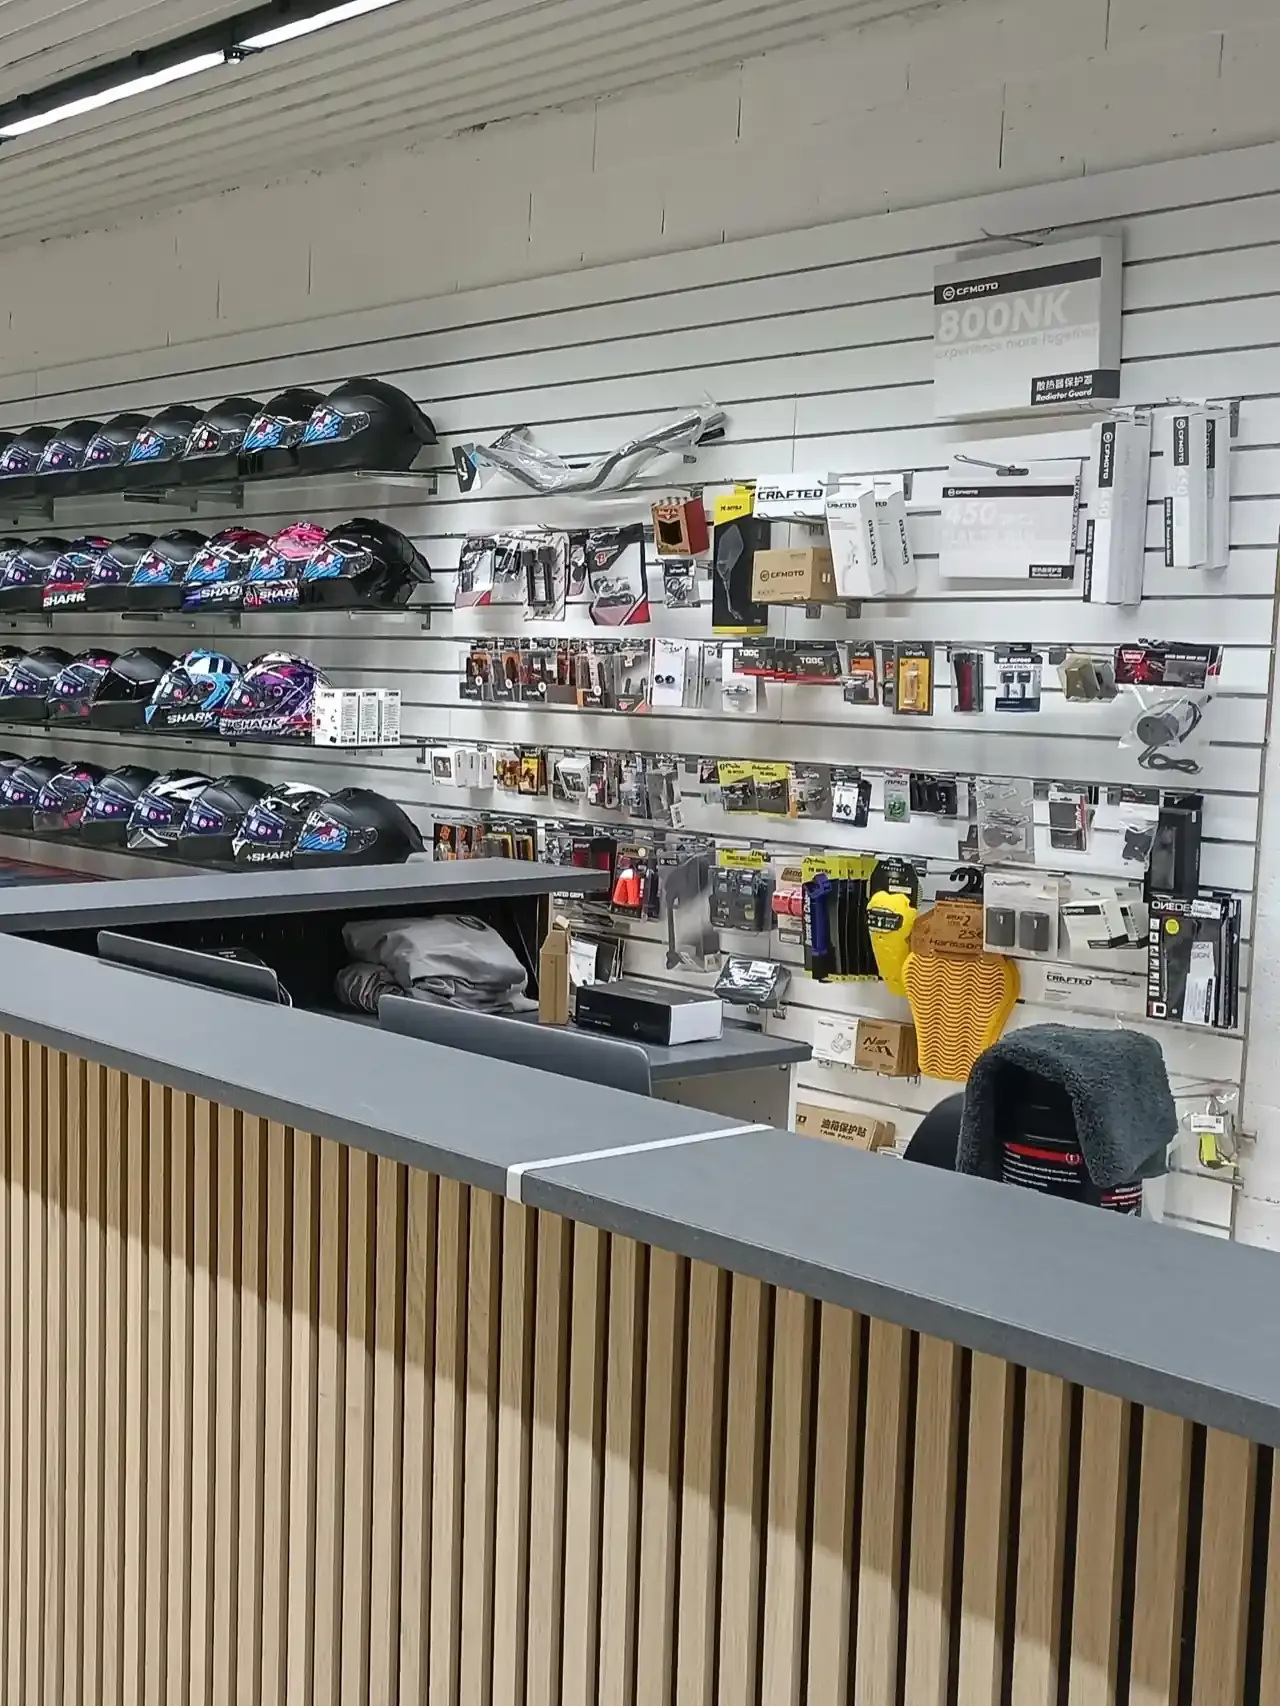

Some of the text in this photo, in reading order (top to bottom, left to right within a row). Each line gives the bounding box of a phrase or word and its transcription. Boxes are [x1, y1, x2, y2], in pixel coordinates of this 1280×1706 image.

[957, 282, 999, 296] CFMOTO
[938, 290, 1070, 343] 800NK
[1006, 335, 1040, 350] more
[1035, 388, 1093, 402] Radiator Guard
[757, 489, 823, 500] CRAFTED
[770, 570, 805, 578] CFMOTO
[43, 592, 86, 608] SHARK
[167, 712, 215, 723] SHARK
[1046, 974, 1093, 986] CRAFTED
